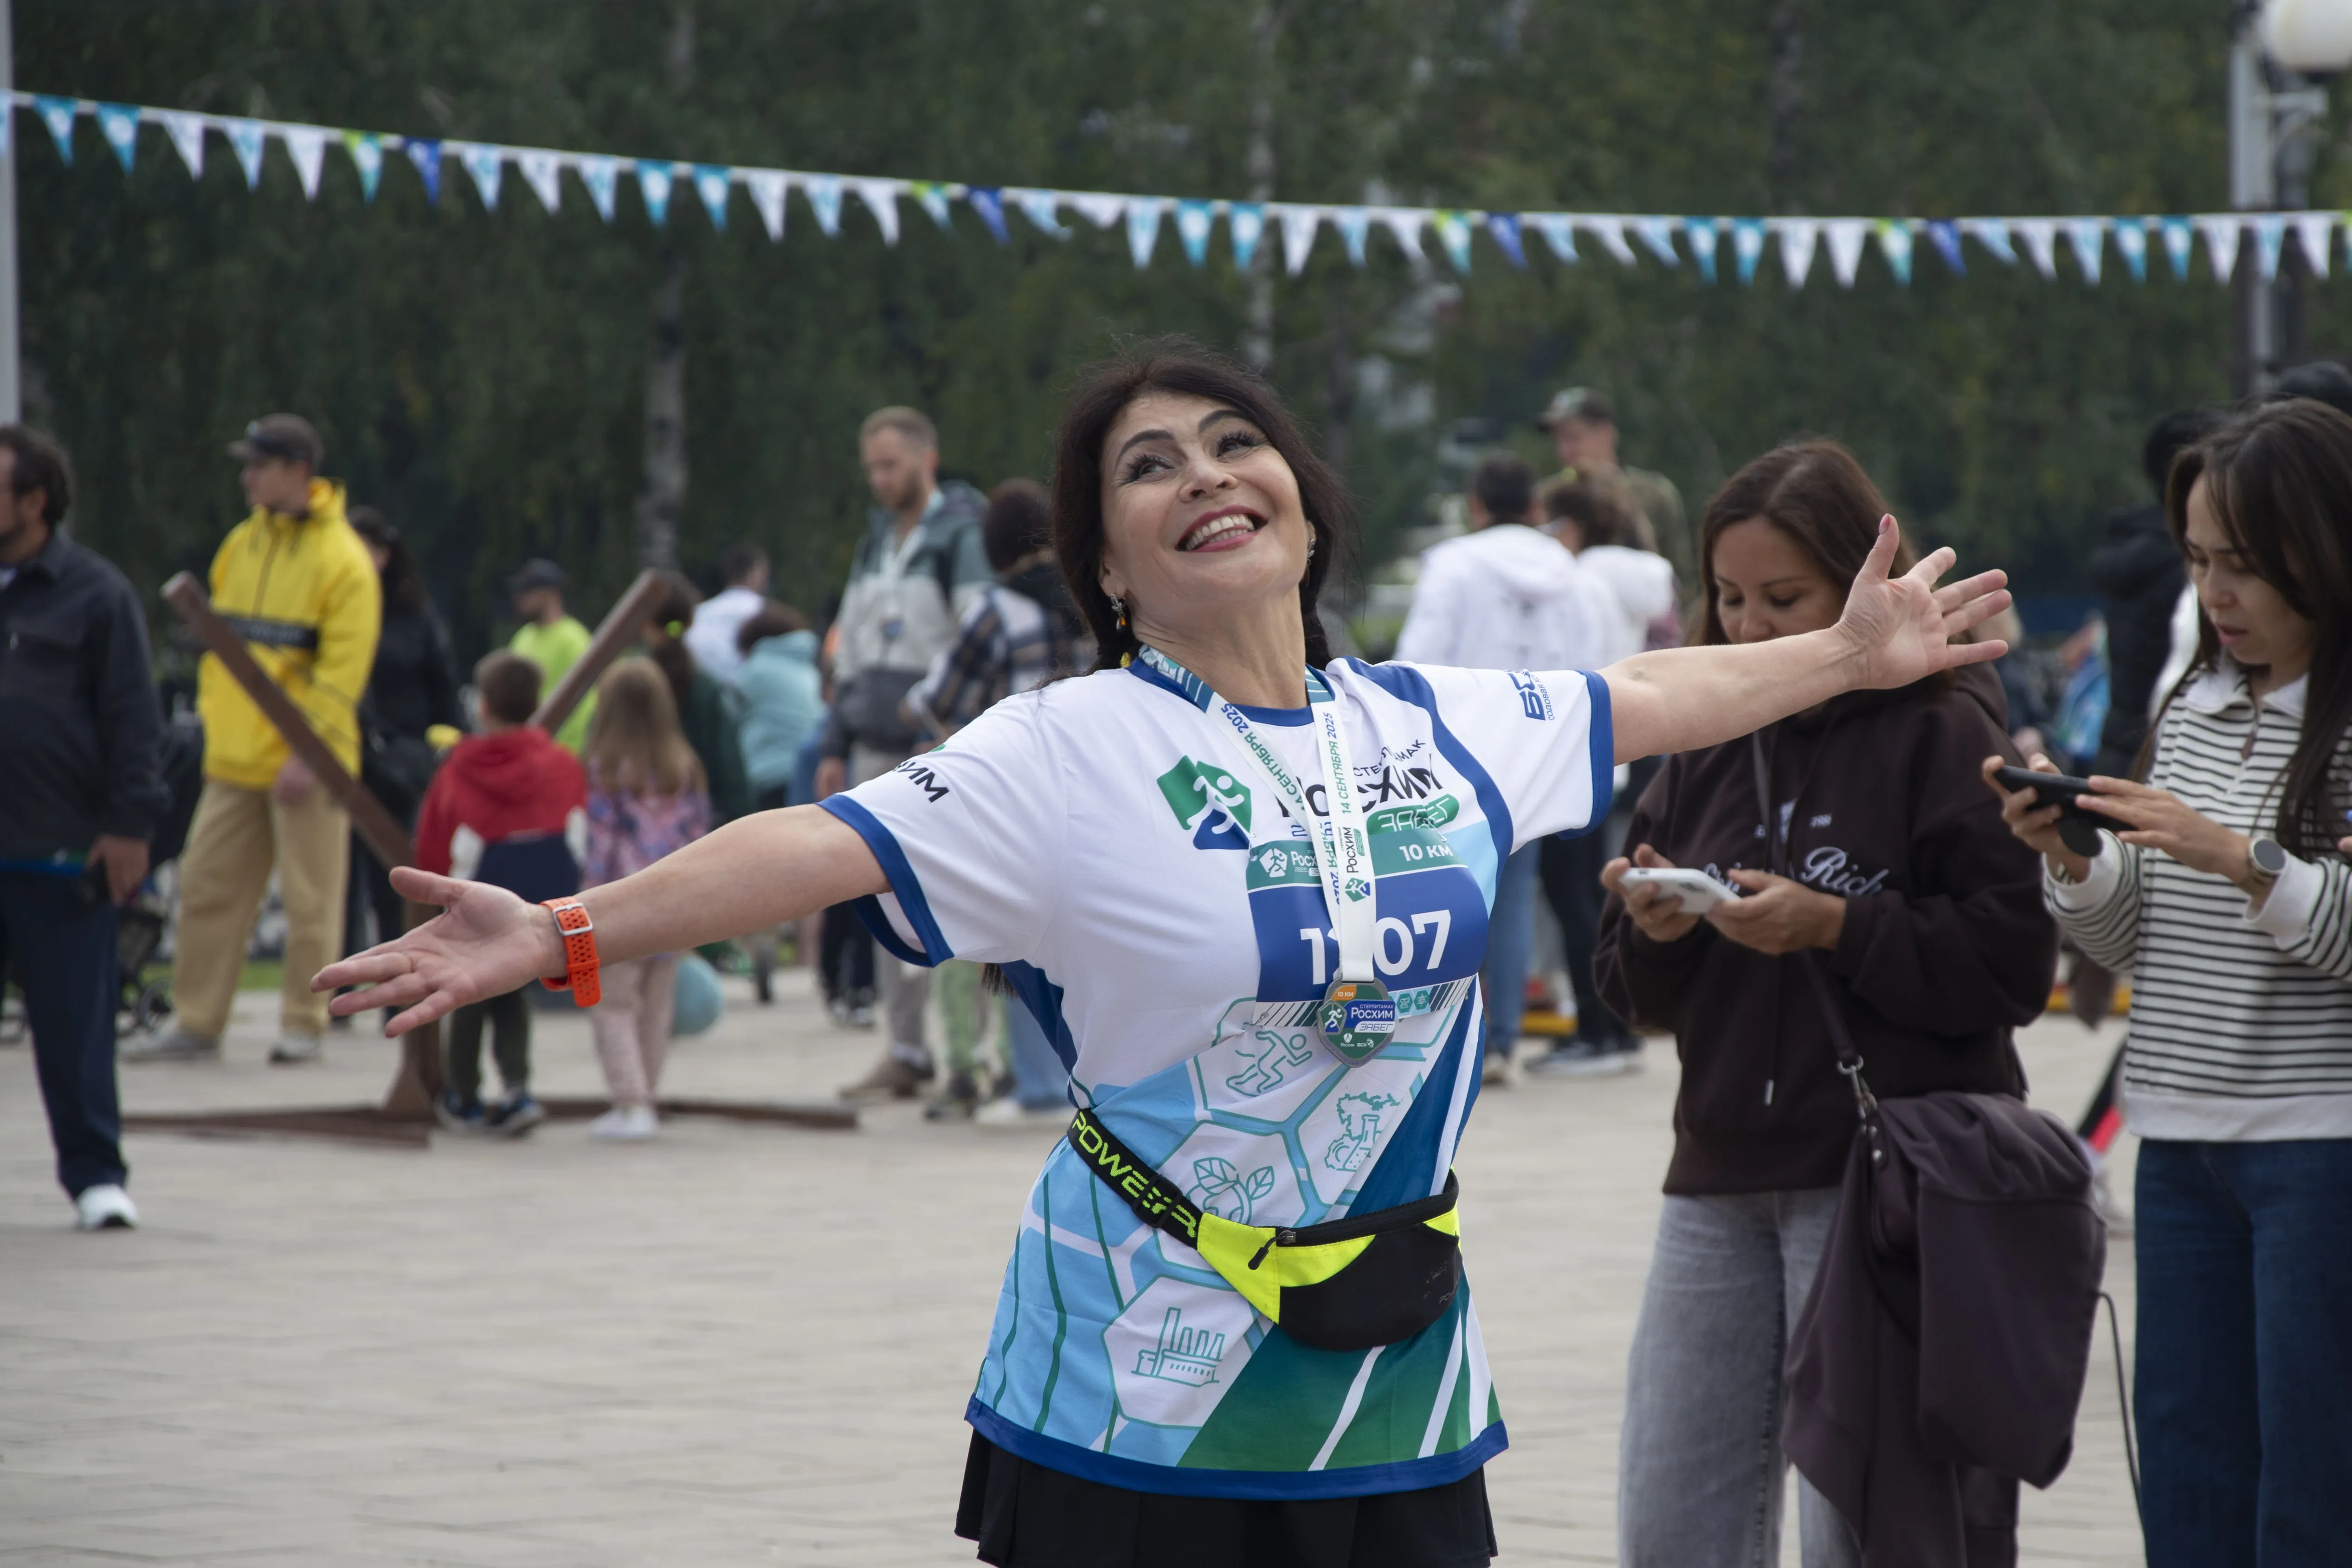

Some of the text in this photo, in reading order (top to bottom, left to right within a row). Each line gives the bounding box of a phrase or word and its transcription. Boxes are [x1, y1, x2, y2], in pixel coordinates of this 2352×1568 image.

[1221, 703, 1249, 733] 2025
[1244, 731, 1297, 795] СЕНТЯБРЯ
[1323, 712, 1351, 814] 14 СЕНТЯБРЯ 2025
[1399, 844, 1453, 861] 10 КМ
[1300, 909, 1451, 985] 107
